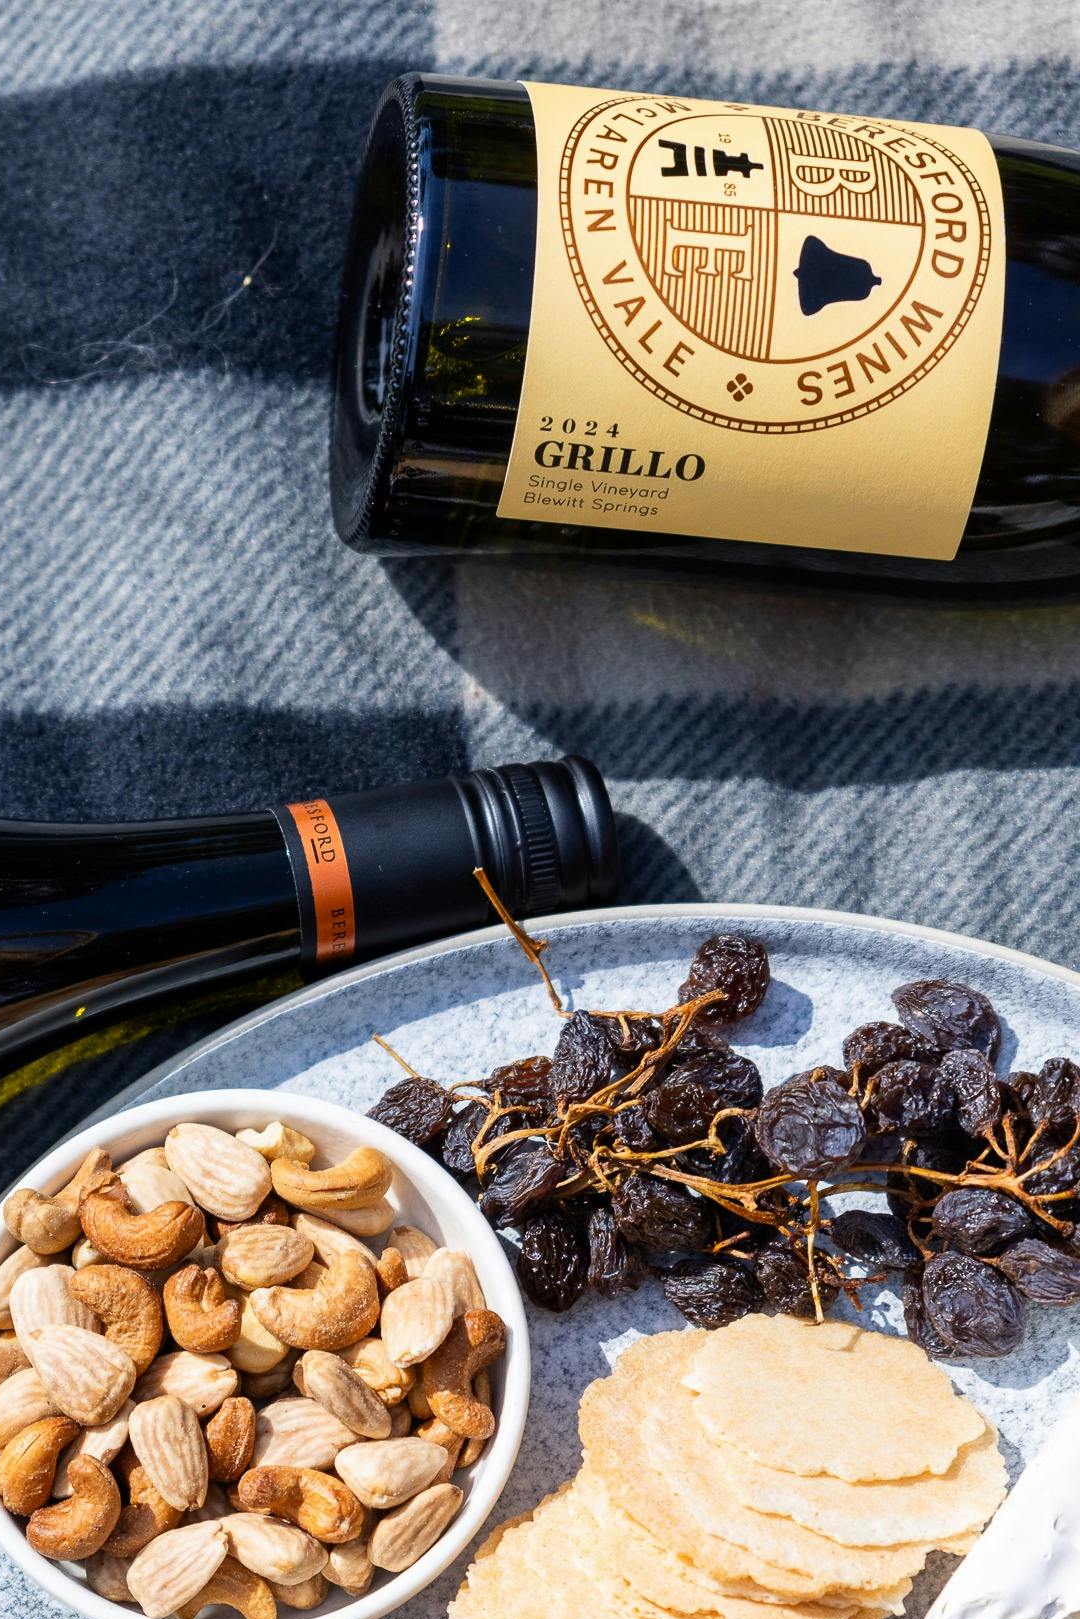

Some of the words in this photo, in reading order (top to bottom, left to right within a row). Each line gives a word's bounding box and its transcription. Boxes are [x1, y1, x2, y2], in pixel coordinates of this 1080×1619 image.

[718, 132, 732, 144] 19
[723, 182, 737, 197] 85
[796, 112, 967, 279] BERESFORD
[601, 260, 695, 376] VALE
[797, 298, 944, 406] WINES
[539, 415, 620, 438] 2024
[534, 440, 706, 482] GRILLO
[528, 474, 583, 493] Single
[591, 480, 670, 500] Vineyard
[523, 491, 585, 509] Blewitt
[591, 498, 659, 517] Springs
